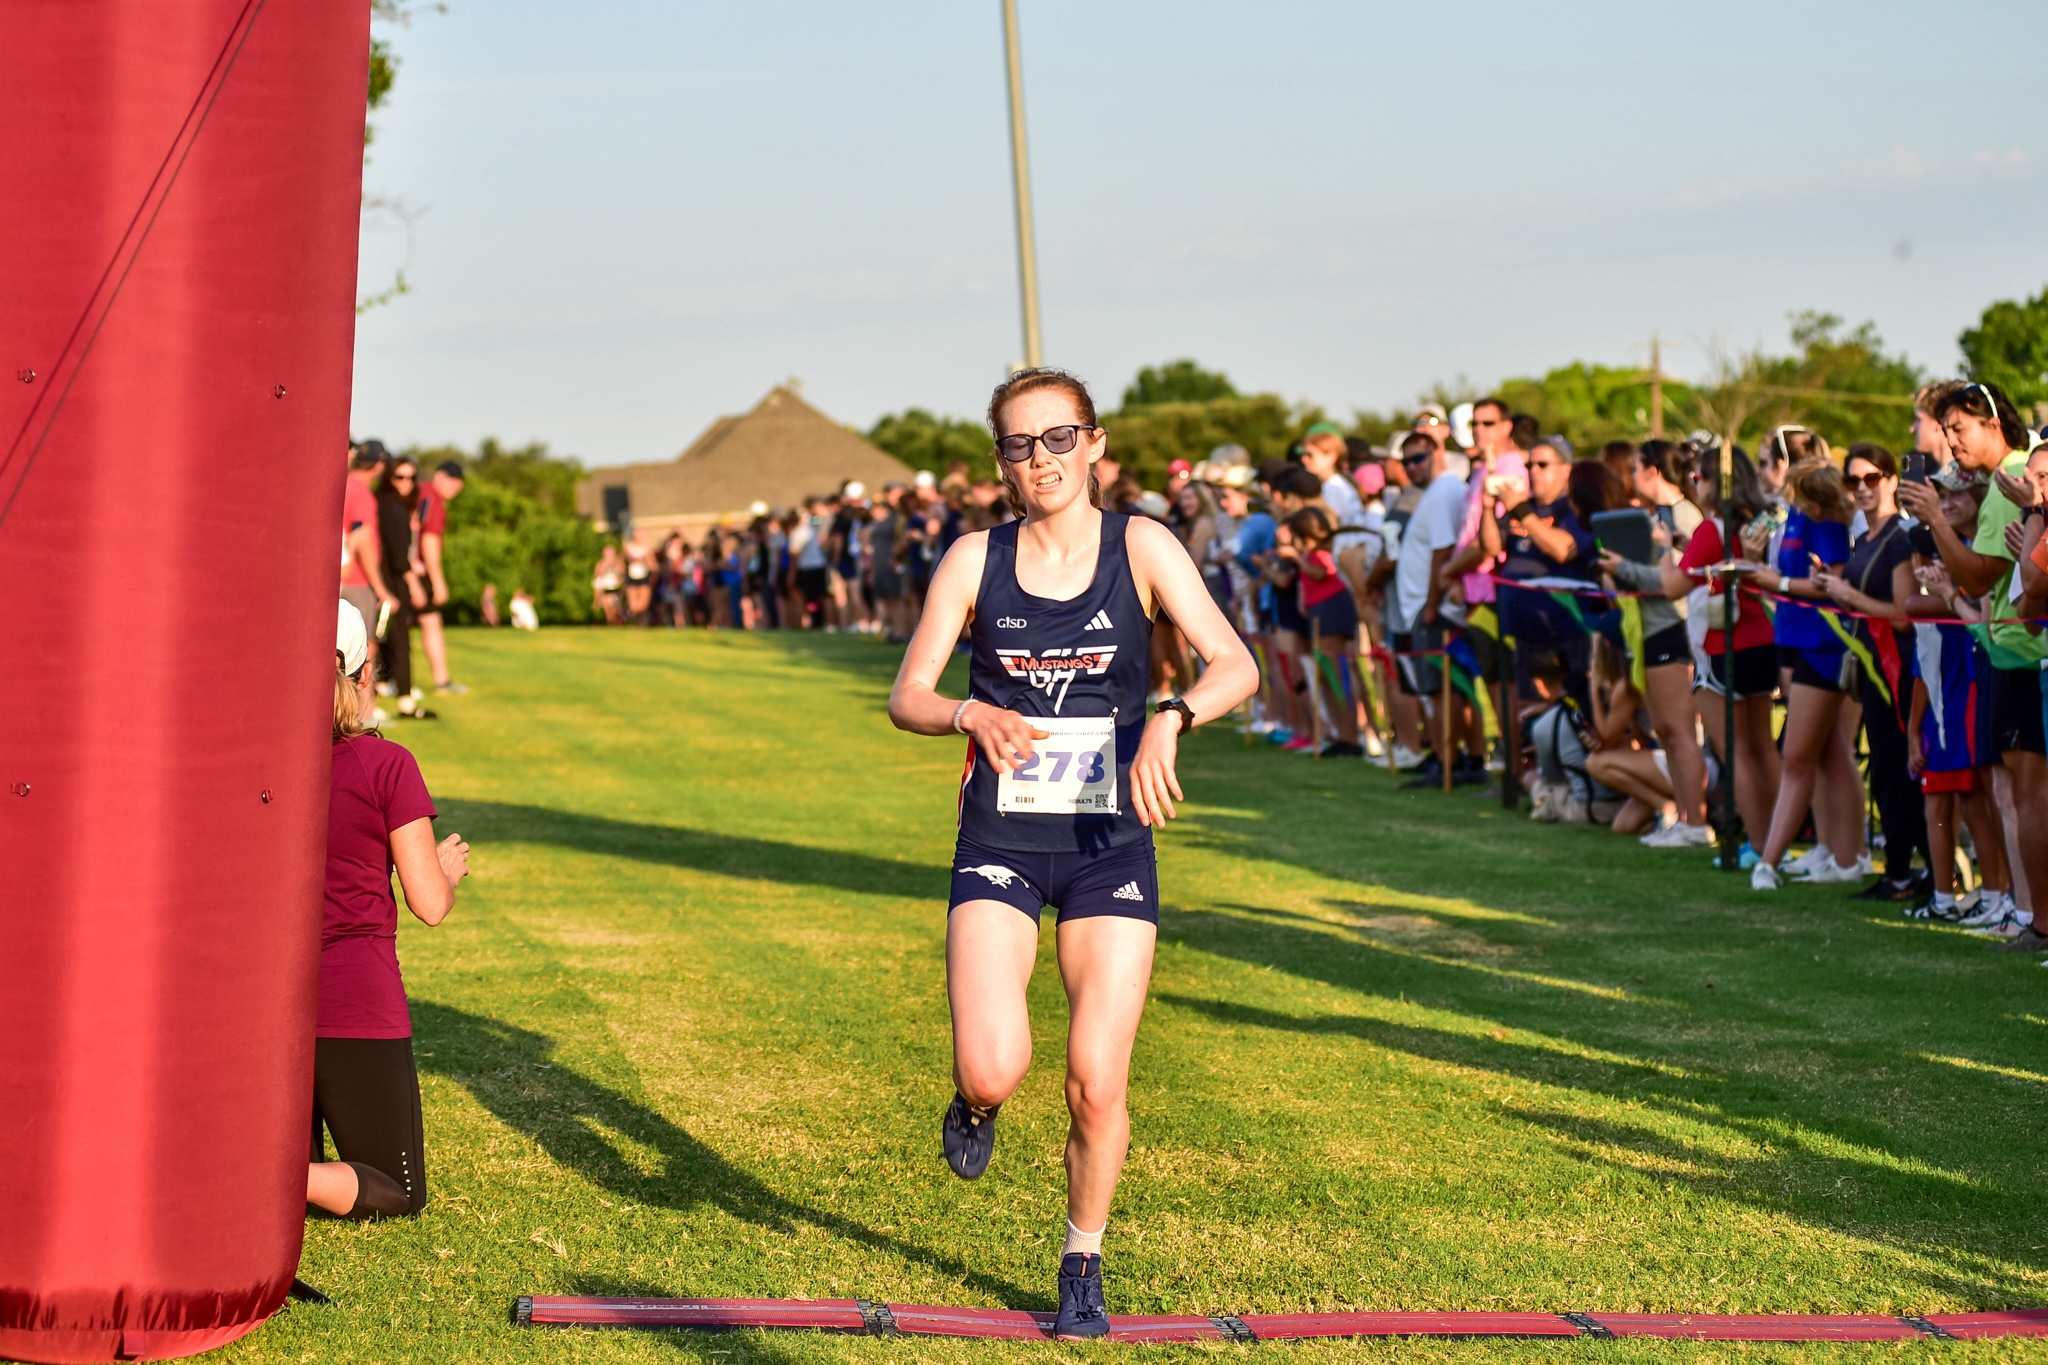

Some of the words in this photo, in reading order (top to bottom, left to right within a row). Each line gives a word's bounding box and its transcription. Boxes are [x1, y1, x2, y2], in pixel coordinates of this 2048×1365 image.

[1020, 654, 1094, 672] MUSTANGS
[1012, 751, 1105, 784] 278
[1112, 891, 1143, 902] adidas
